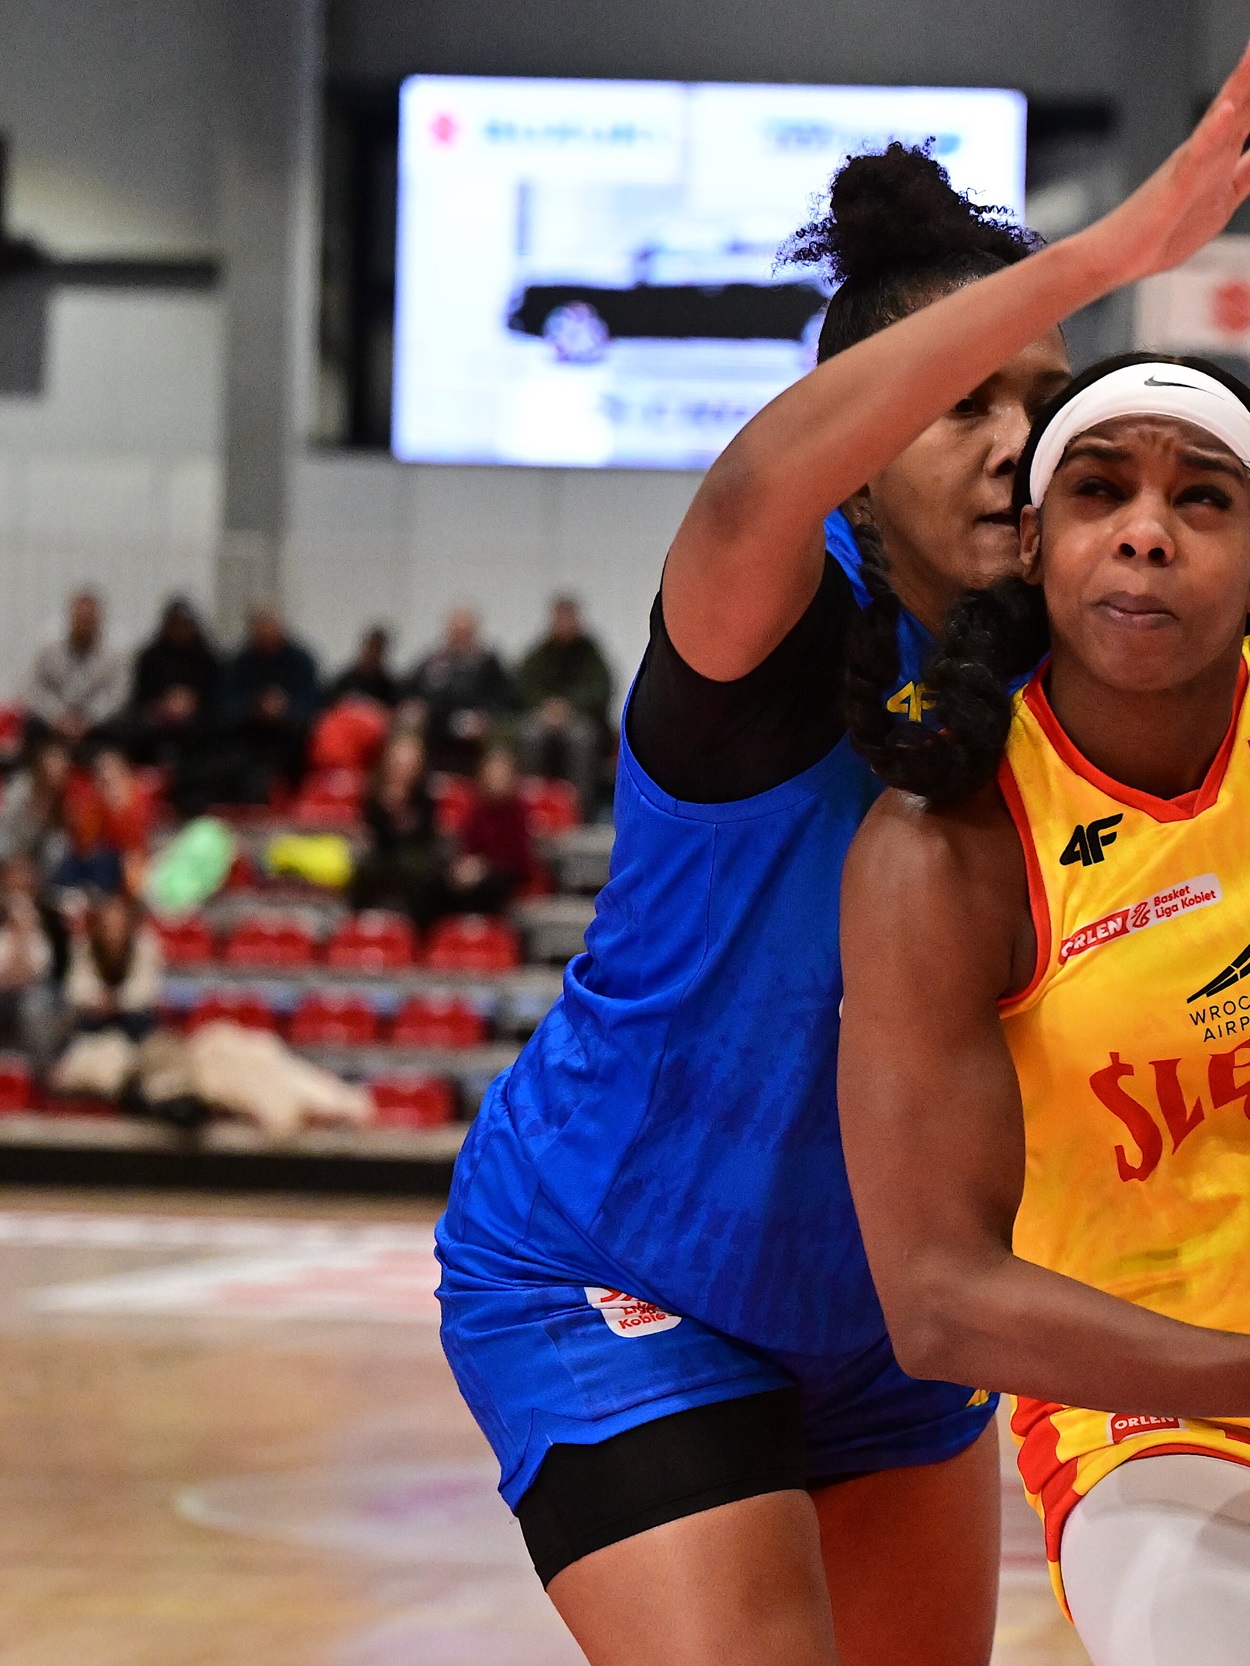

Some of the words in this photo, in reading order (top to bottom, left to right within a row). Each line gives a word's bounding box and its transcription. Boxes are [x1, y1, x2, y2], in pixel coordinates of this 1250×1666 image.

[1059, 813, 1123, 867] 4F
[1153, 885, 1191, 907] Basket
[1155, 904, 1179, 919] Liga
[1180, 889, 1217, 910] Kobiet
[618, 1312, 668, 1329] Kobie
